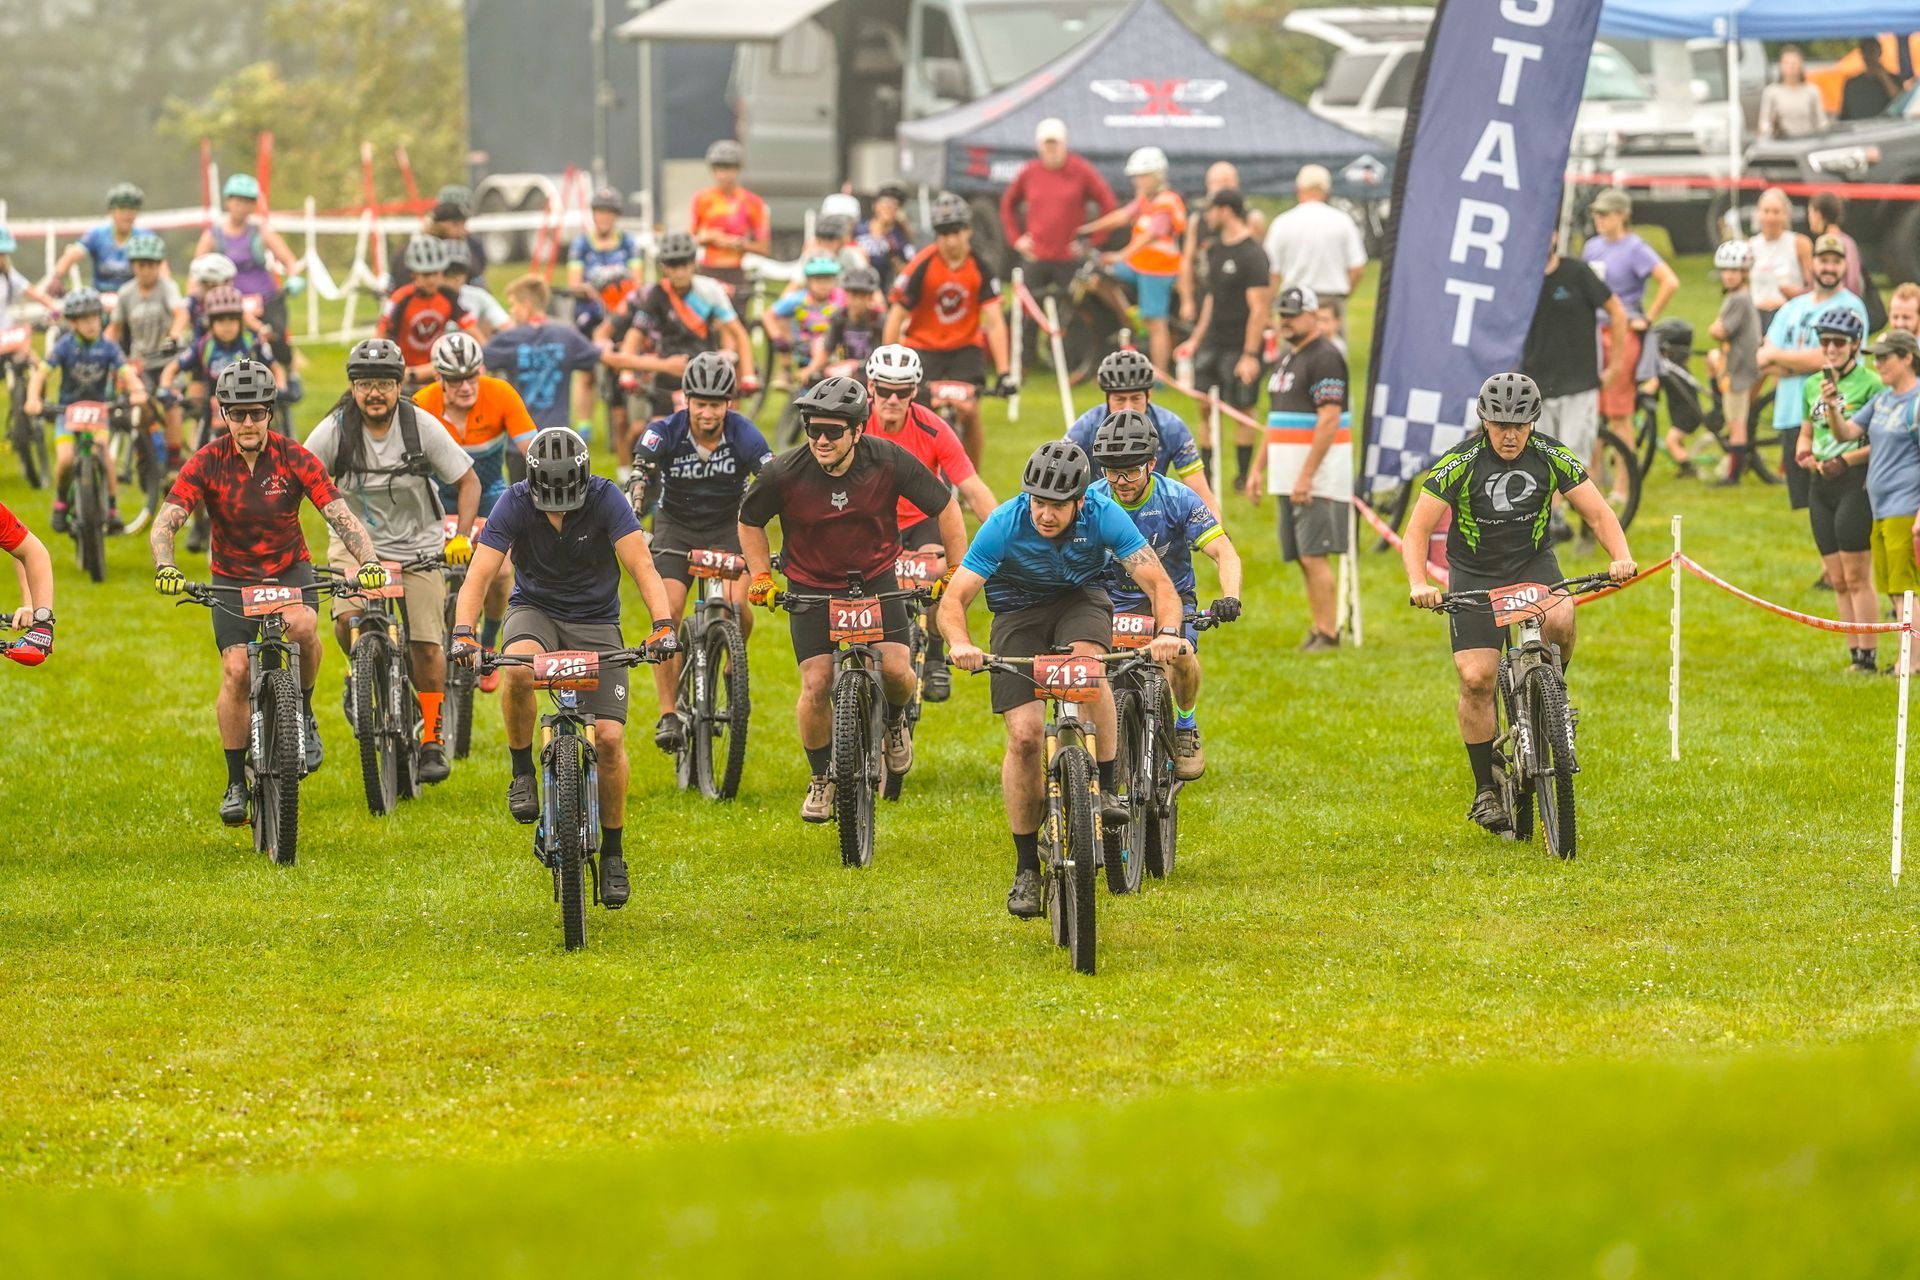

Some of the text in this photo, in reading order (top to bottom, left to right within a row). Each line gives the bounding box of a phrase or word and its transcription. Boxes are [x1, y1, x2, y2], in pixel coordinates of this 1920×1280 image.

[669, 457, 736, 479] RACING
[1434, 446, 1481, 483] PEARL IZUM
[701, 550, 735, 570] 314
[253, 587, 291, 602] 254
[1502, 586, 1538, 611] 300
[837, 609, 872, 628] 210
[545, 657, 587, 677] 236
[1046, 664, 1087, 685] 213
